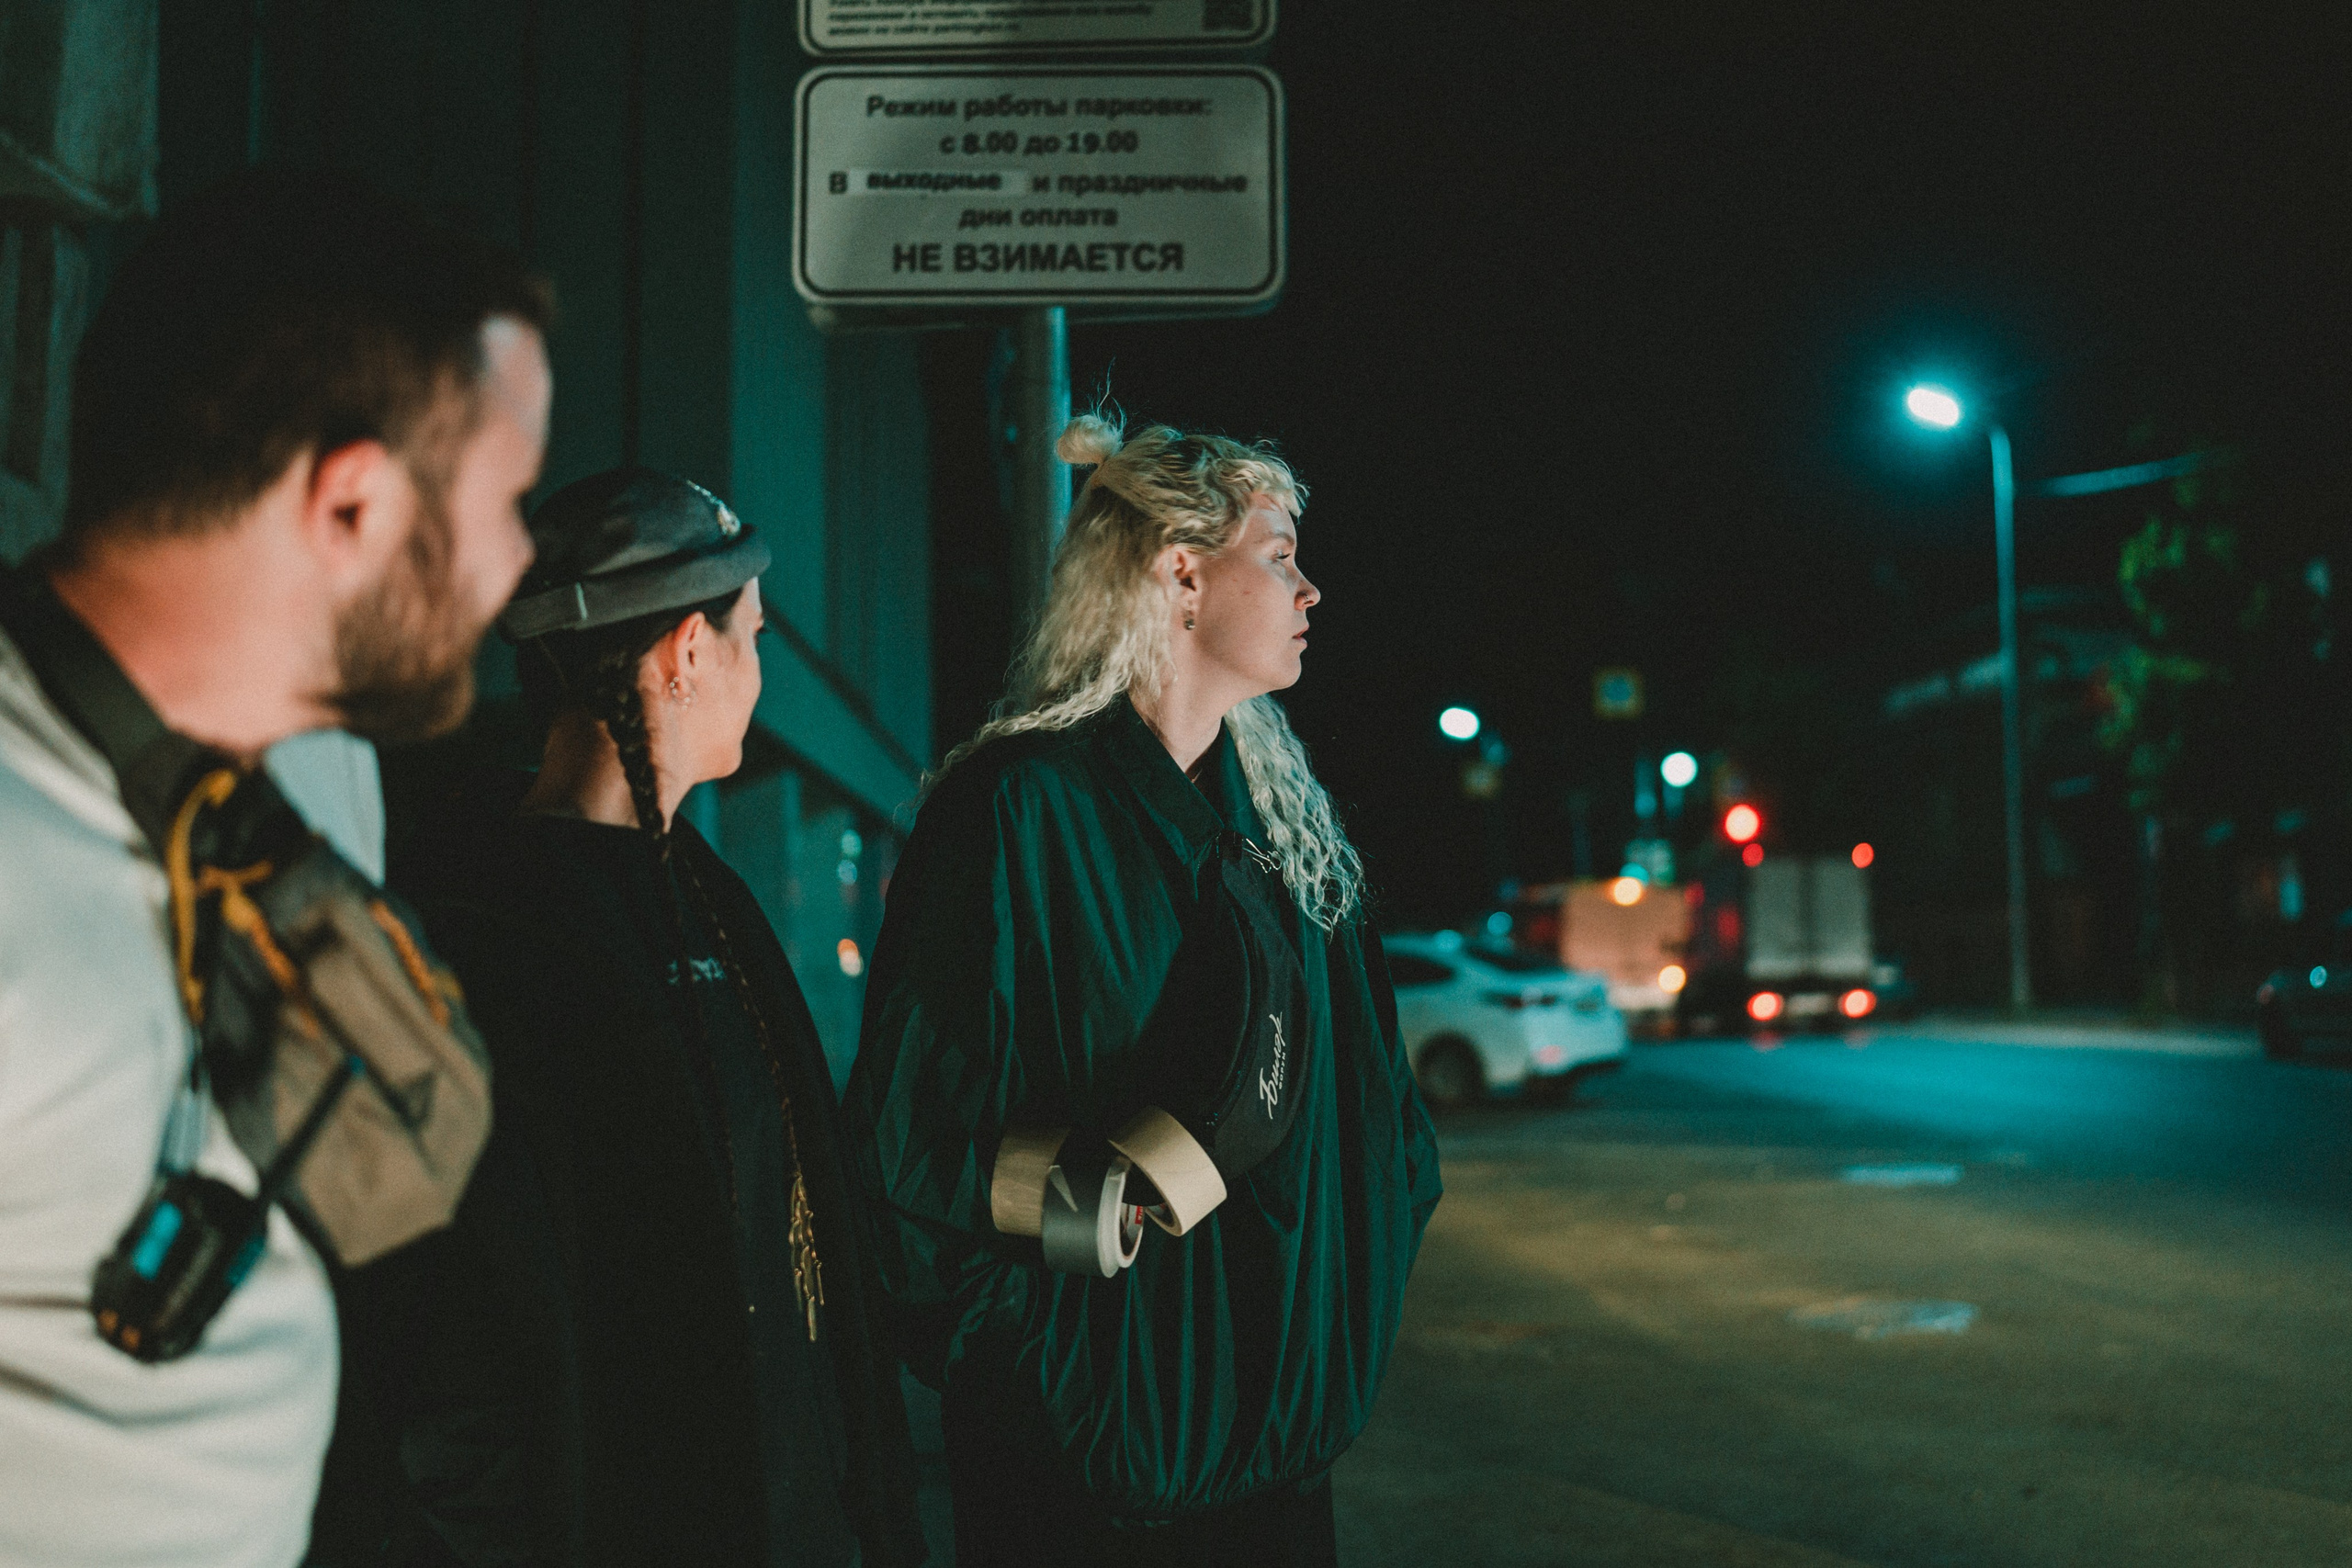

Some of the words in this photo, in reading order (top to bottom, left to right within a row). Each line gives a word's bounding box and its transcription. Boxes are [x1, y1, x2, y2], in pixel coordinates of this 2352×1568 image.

[865, 95, 957, 118] Режим
[963, 94, 1069, 121] работы
[1074, 97, 1214, 120] парковки:
[939, 135, 956, 155] с
[961, 130, 1019, 155] 8.00
[1023, 135, 1062, 156] до
[1066, 130, 1139, 155] 19.00
[866, 172, 1003, 192] выходные
[1032, 175, 1050, 194] и
[1057, 174, 1250, 197] праздничные
[957, 209, 1012, 230] дни
[1019, 208, 1119, 228] оплата
[892, 243, 943, 273] НЕ
[953, 242, 1185, 273] ВЗИМАЕТСЯ
